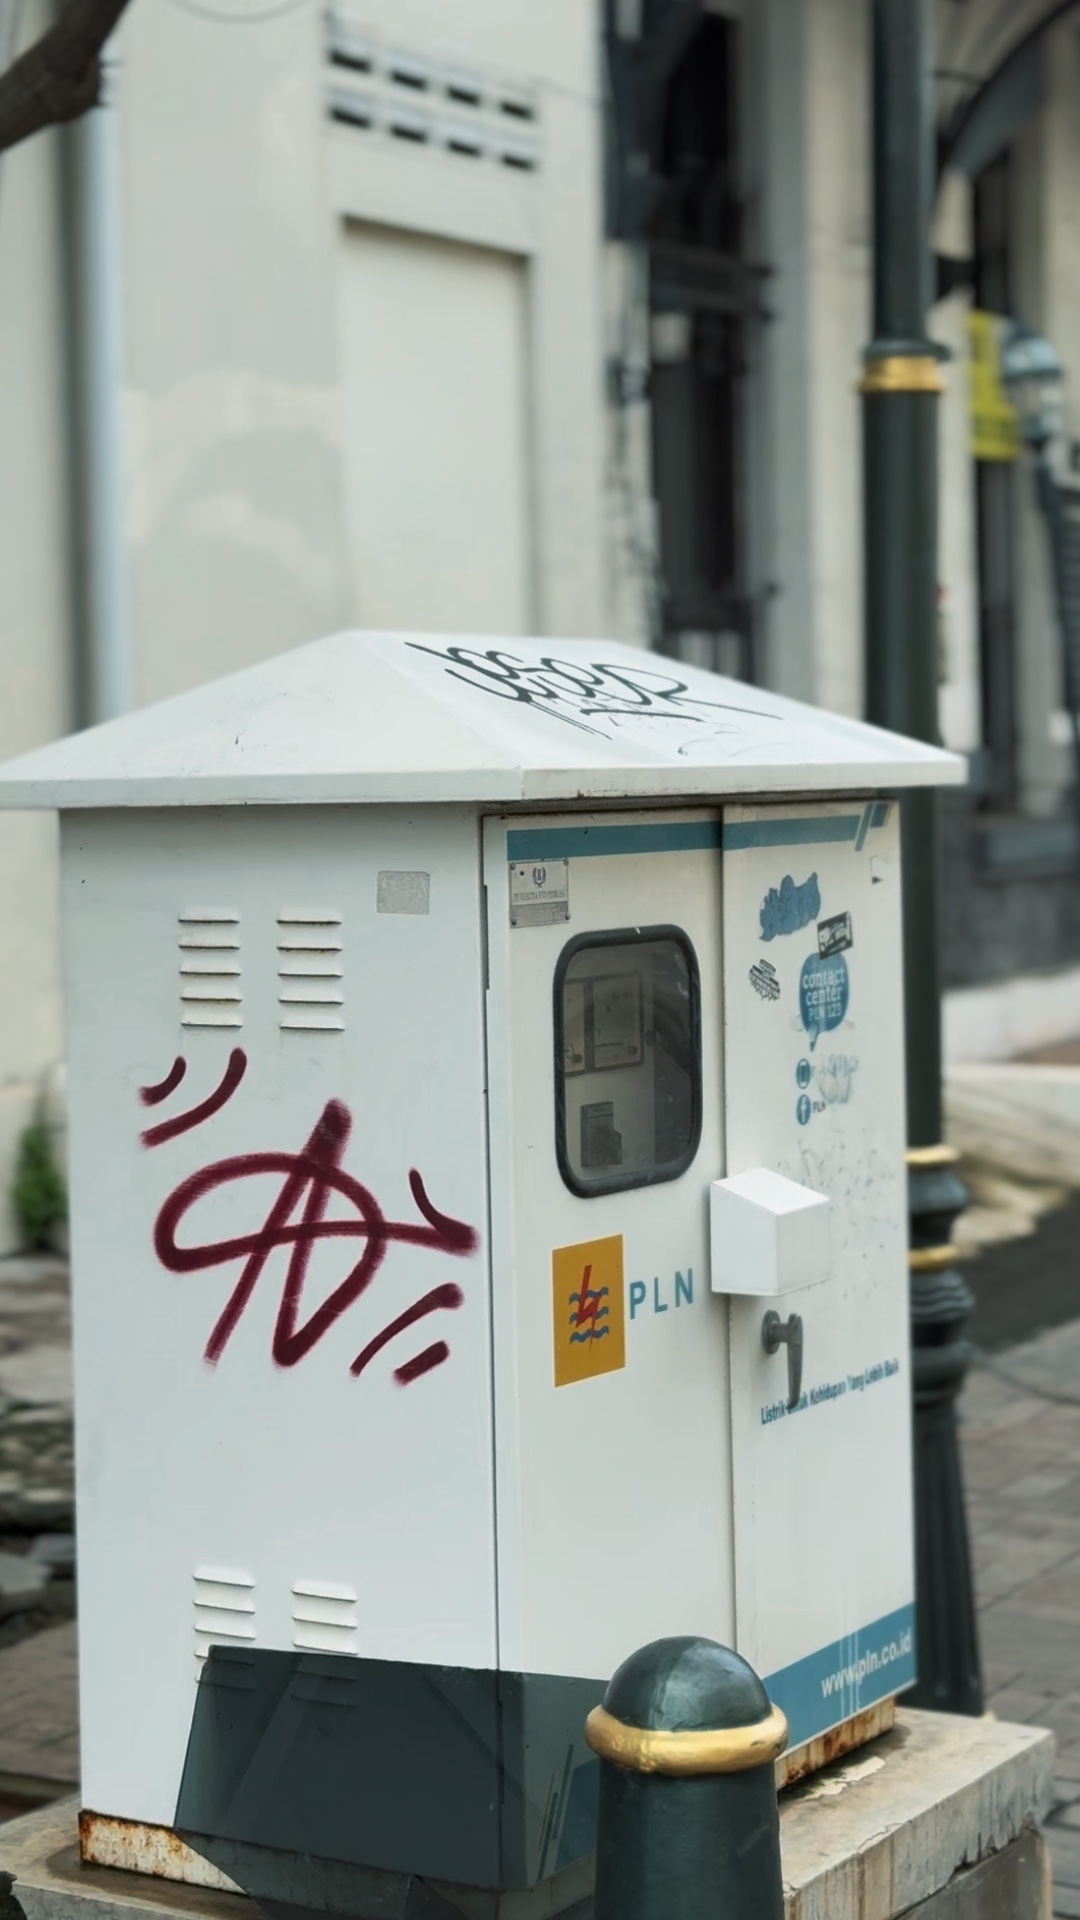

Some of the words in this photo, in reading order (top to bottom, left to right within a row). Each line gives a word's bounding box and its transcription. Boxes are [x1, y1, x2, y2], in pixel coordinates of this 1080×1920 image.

[802, 967, 845, 988] contact
[805, 986, 842, 1006] center
[808, 1006, 825, 1022] PLN
[827, 1003, 842, 1018] 123
[629, 1267, 693, 1320] PLN
[761, 1399, 786, 1425] Listrik
[809, 1382, 846, 1406] Kehidupan
[847, 1375, 864, 1392] Yang
[864, 1363, 883, 1385] Lebih
[821, 1626, 912, 1698] www.pln.co.id
